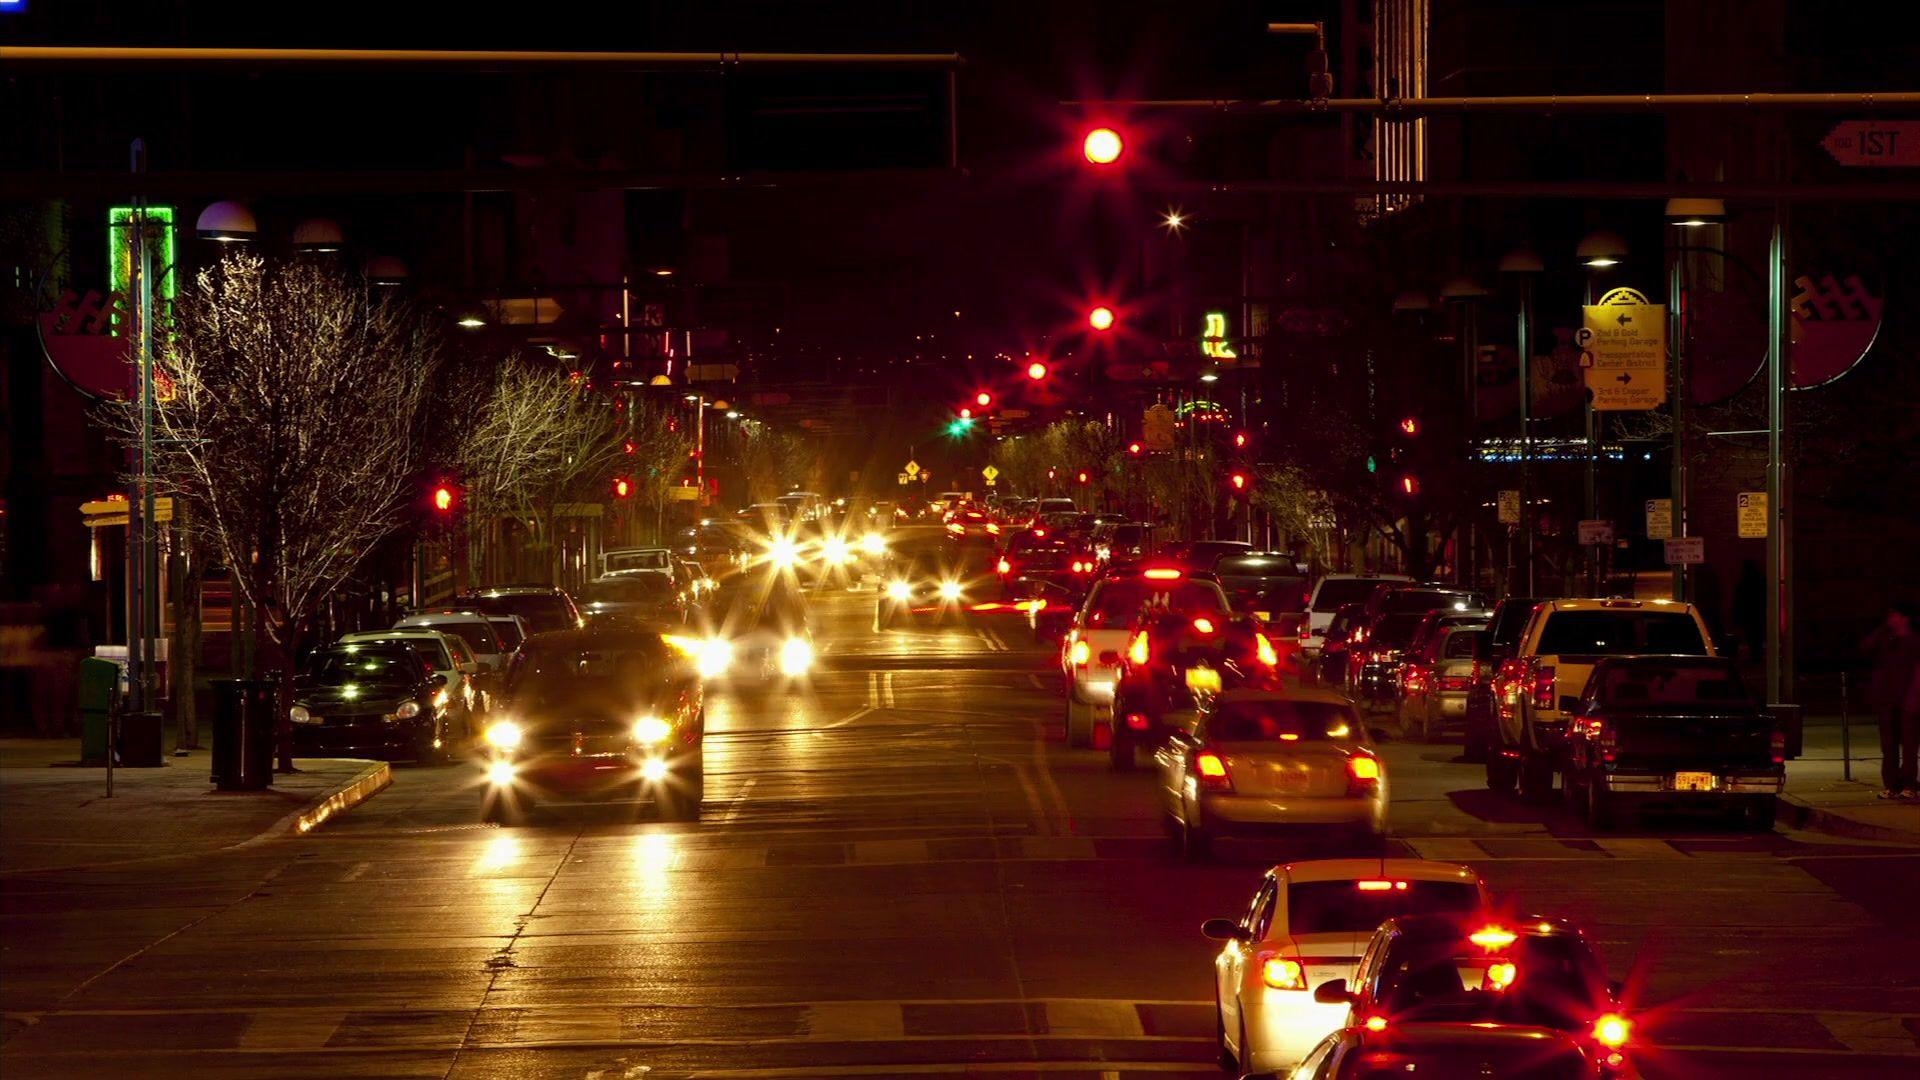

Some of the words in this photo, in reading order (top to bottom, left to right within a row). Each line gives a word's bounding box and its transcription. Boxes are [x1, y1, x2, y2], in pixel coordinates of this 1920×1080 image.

[1858, 131, 1901, 155] 1ST
[1579, 330, 1591, 345] P
[1597, 338, 1627, 347] Parking
[1629, 338, 1658, 347] Garage
[1740, 497, 1748, 506] 2
